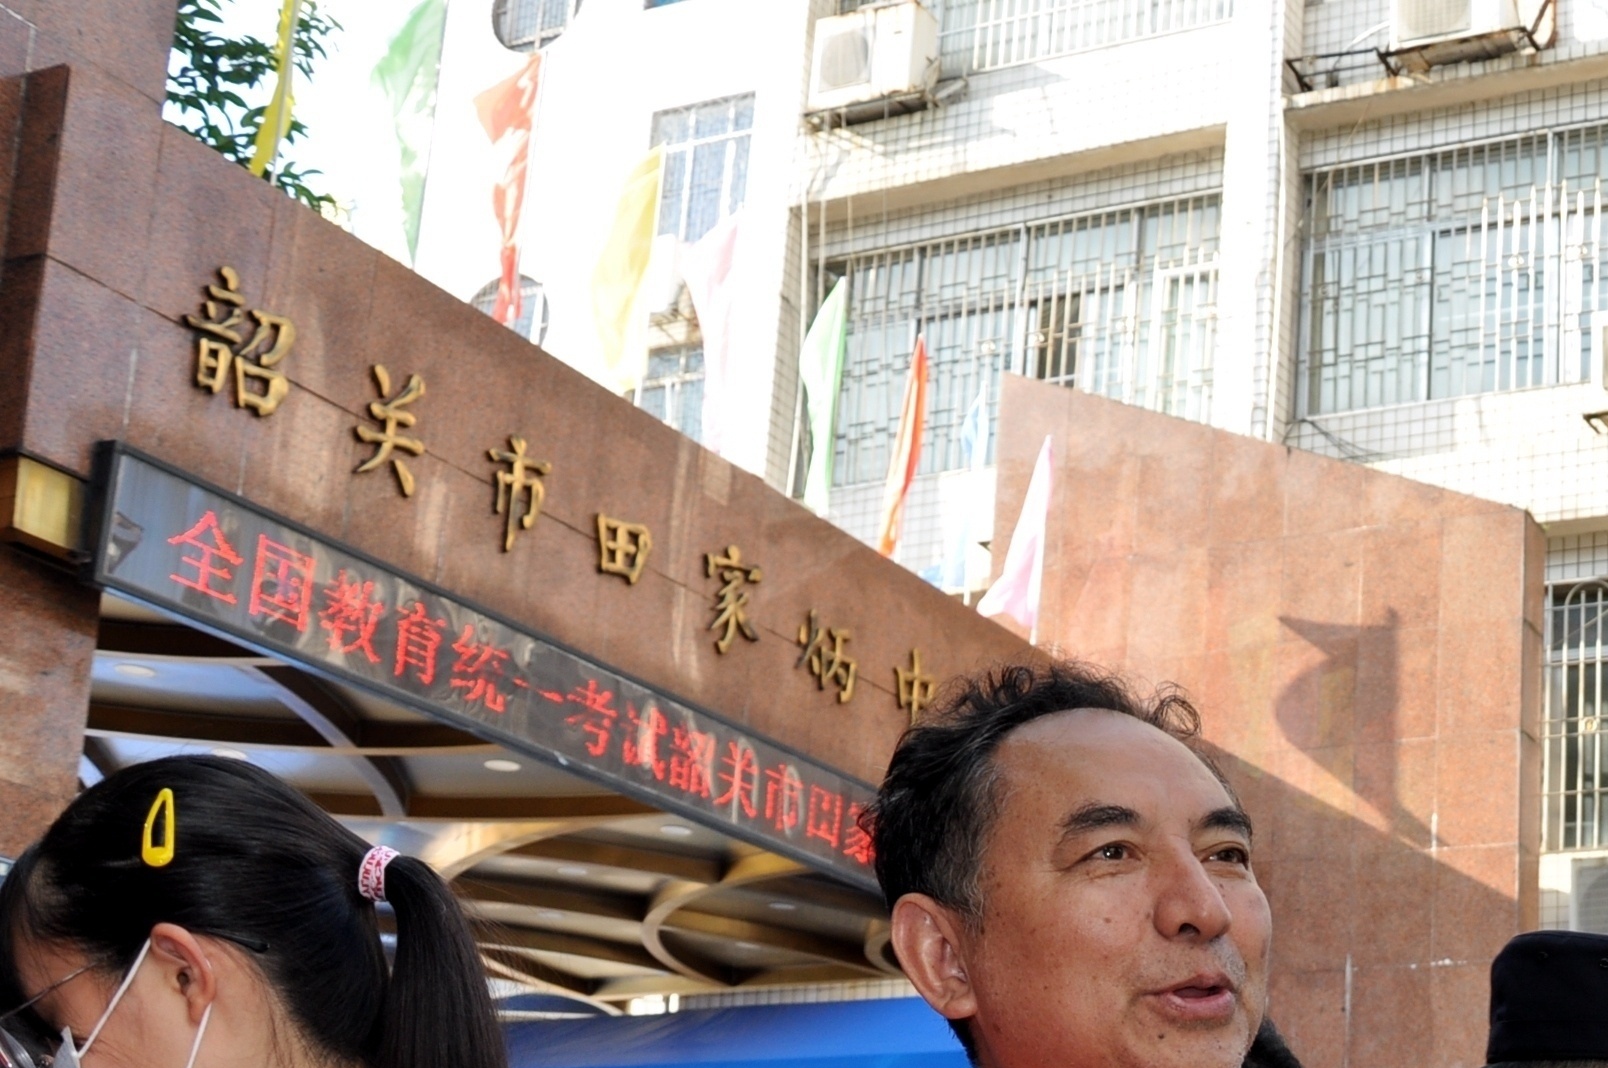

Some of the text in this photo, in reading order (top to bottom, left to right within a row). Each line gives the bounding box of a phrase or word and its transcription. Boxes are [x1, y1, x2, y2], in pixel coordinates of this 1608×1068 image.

[184, 265, 938, 727] 韶关市田家炳中
